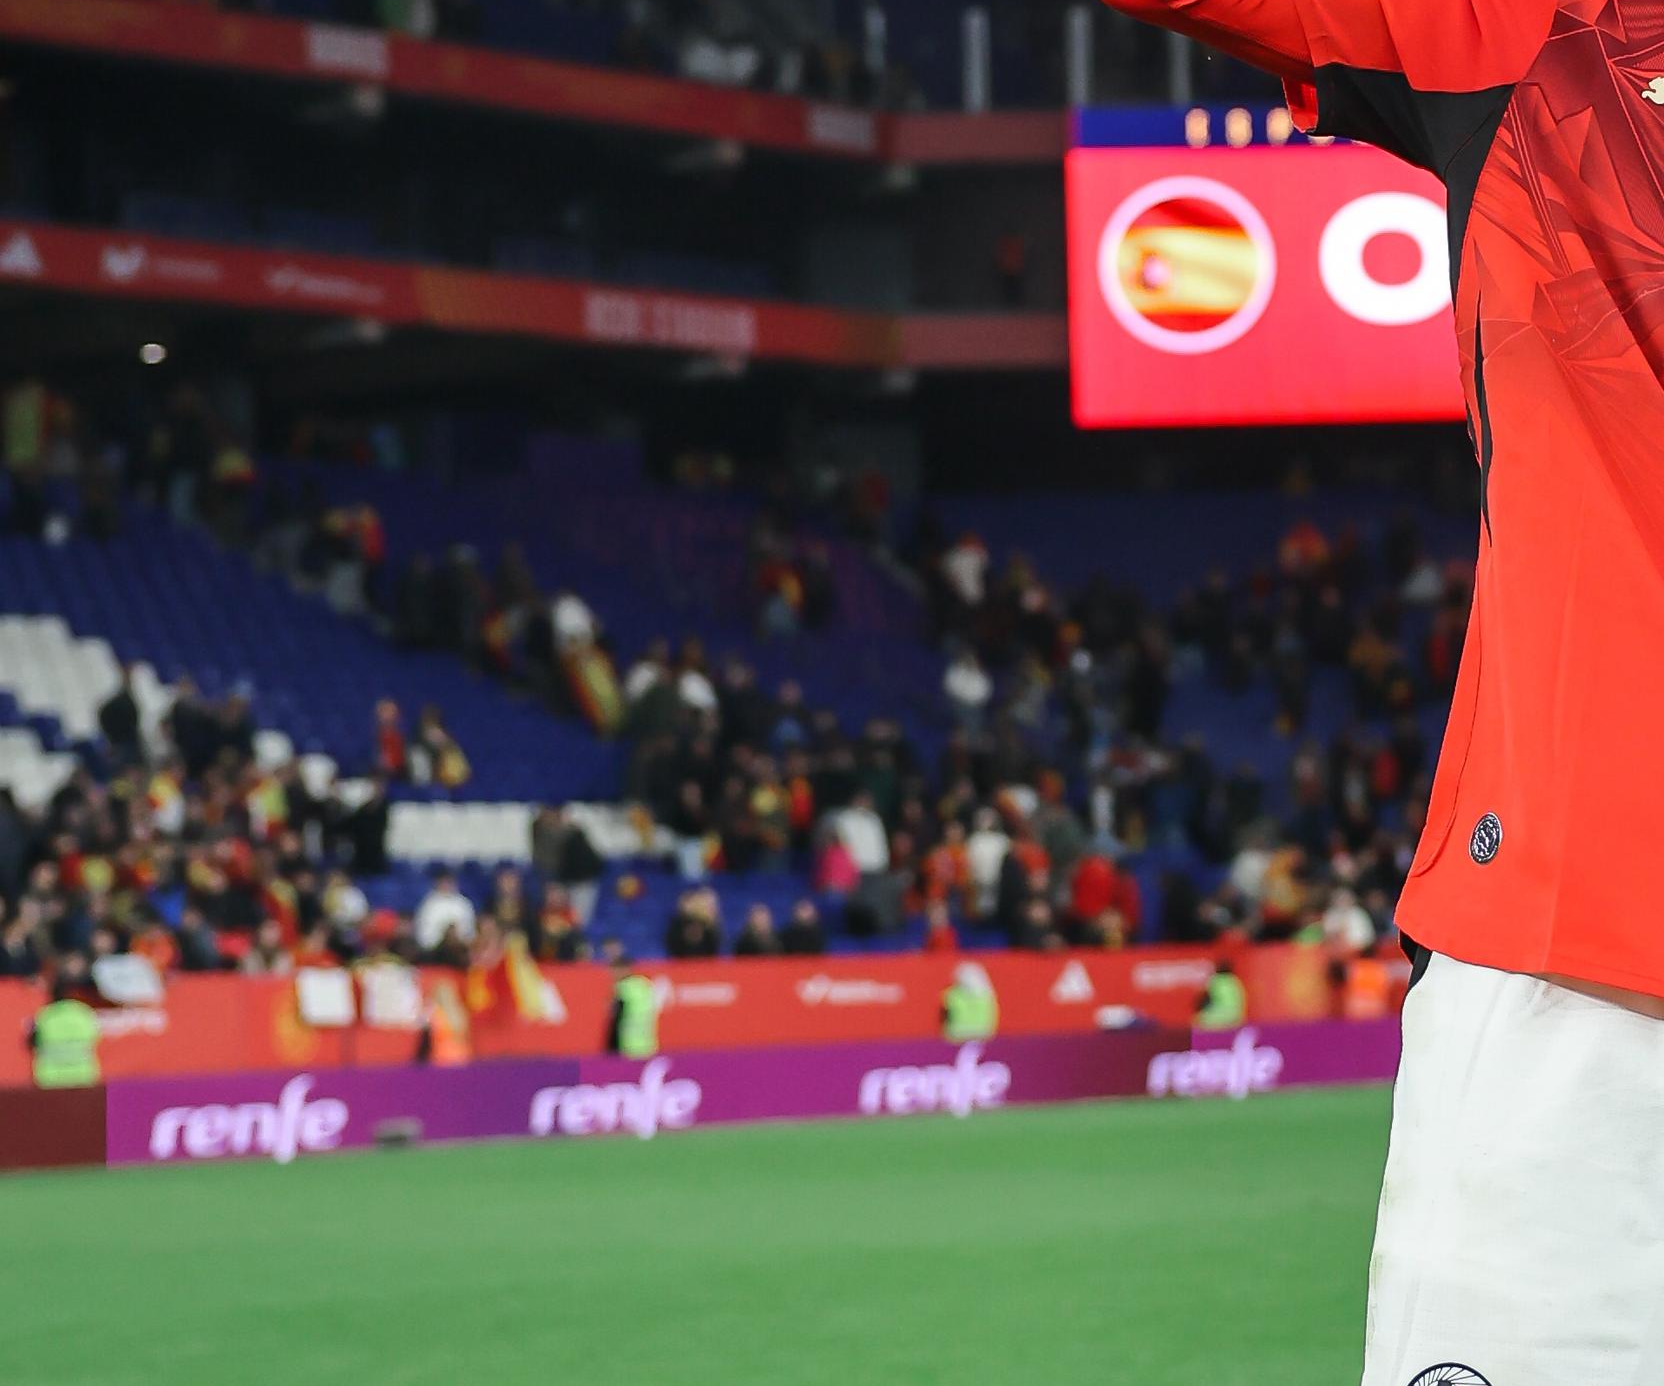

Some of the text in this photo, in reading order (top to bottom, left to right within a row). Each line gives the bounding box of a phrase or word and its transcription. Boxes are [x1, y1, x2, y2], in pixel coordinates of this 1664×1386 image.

[529, 1056, 702, 1140] renfe
[859, 1040, 1012, 1119] renfe
[1147, 1026, 1285, 1100] renfe
[151, 1073, 349, 1164] renfe
